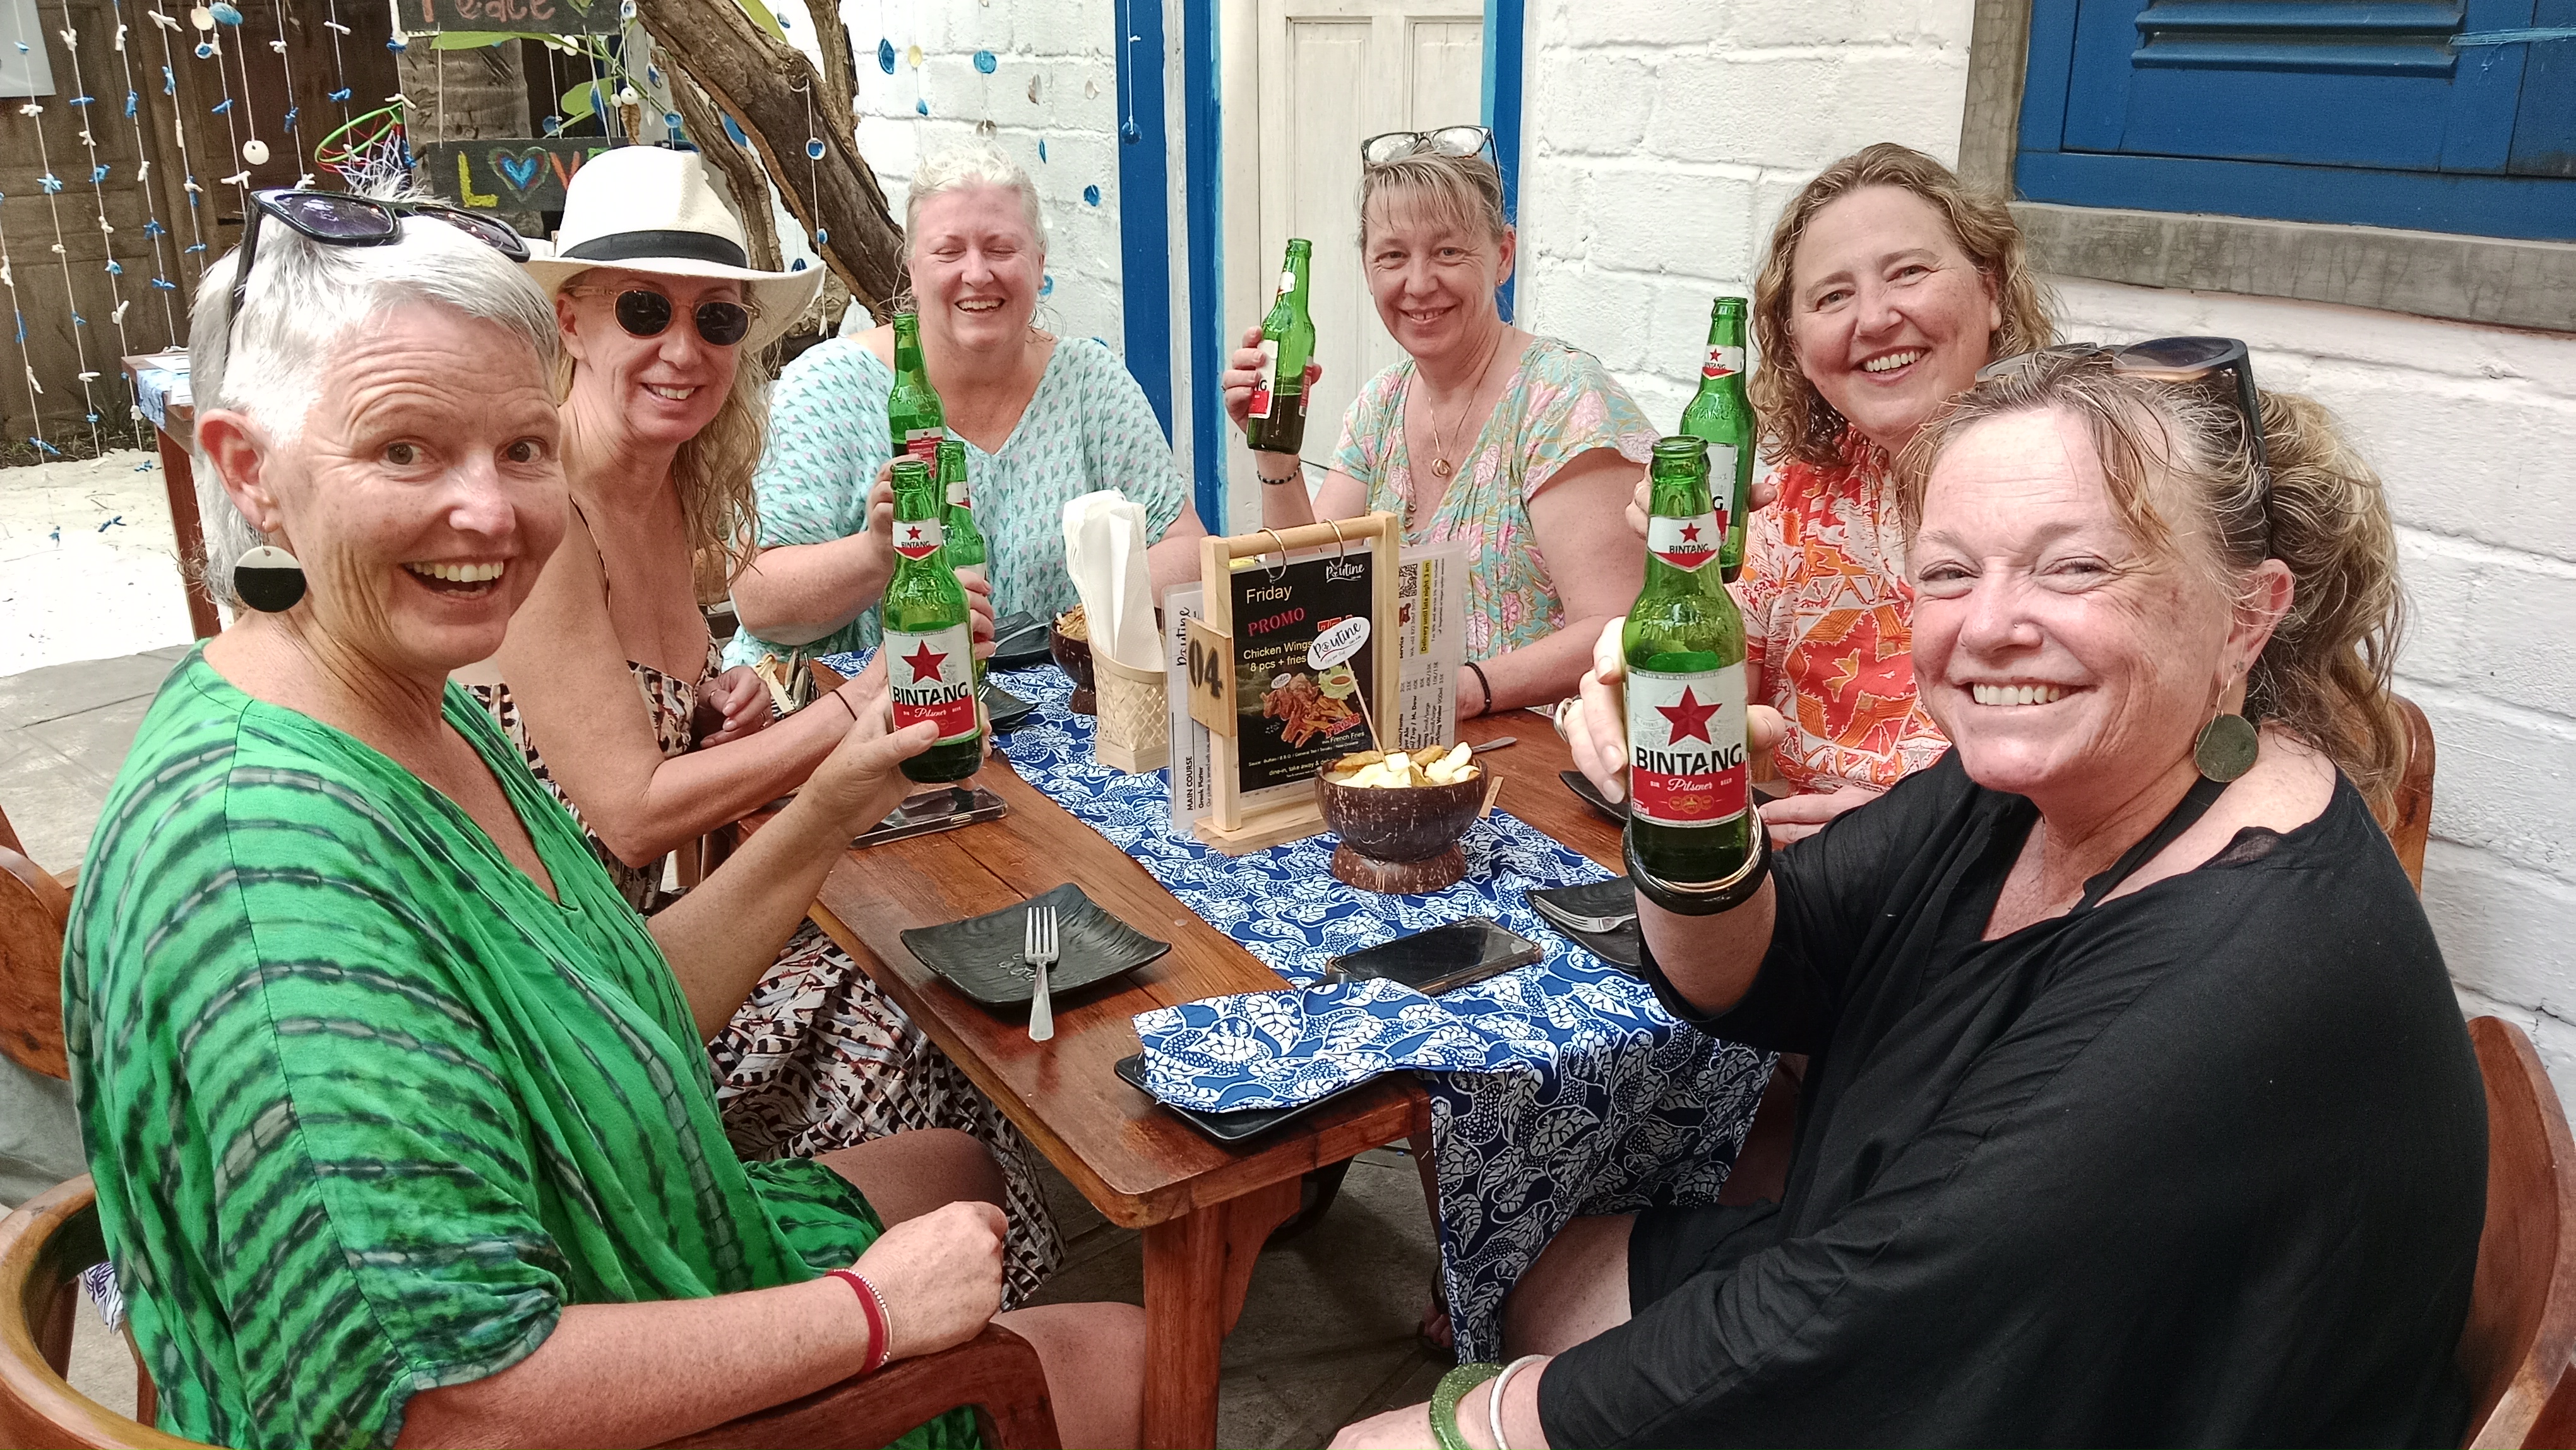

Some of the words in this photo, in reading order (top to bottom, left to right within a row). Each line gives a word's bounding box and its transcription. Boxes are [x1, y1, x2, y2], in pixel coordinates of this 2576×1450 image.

[1669, 543, 1709, 554] BINTANG
[1246, 585, 1292, 604] Friday
[1421, 626, 1429, 652] Delivery
[1425, 562, 1430, 573] am
[1248, 607, 1306, 637] PROMO
[1243, 644, 1282, 659] Chicken
[1284, 640, 1313, 652] Wings
[1188, 637, 1223, 700] 04
[1250, 662, 1256, 672] 8
[1259, 660, 1276, 673] pcs
[1287, 654, 1307, 665] fries
[892, 681, 968, 706] BINTANG
[1330, 734, 1350, 743] French
[1635, 743, 1743, 776] BINTANG
